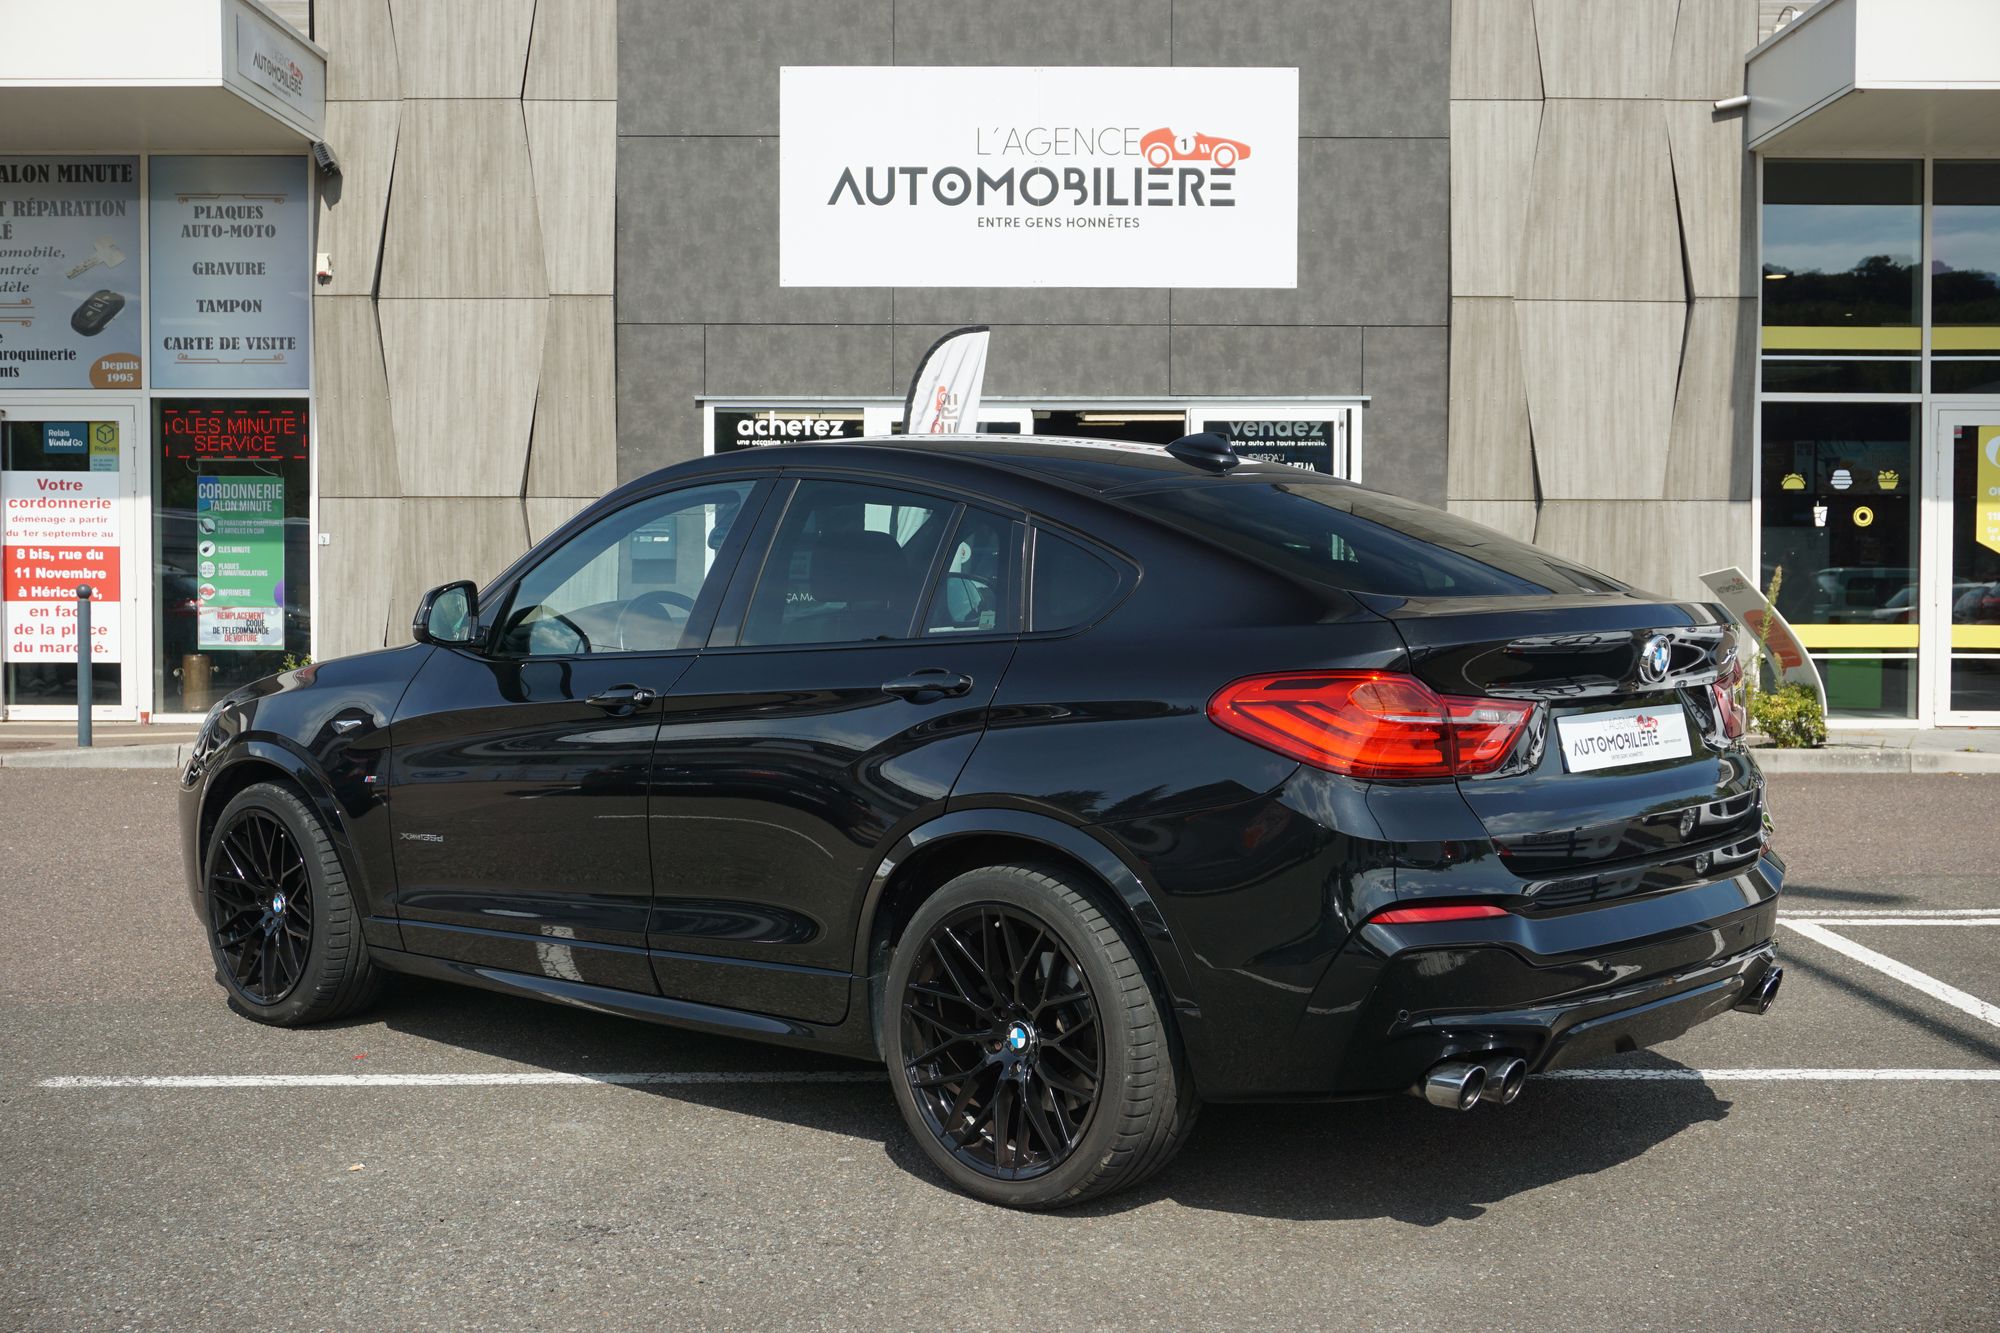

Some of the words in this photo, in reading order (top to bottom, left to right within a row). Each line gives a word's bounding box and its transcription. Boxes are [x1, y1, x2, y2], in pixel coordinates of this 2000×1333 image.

[977, 127, 1140, 156] L'AGENCE
[1181, 138, 1187, 151] 1
[57, 163, 133, 183] MINUTE
[827, 166, 1236, 207] AUTOMOBILIERE
[13, 197, 127, 217] RÉPARATION
[193, 205, 264, 220] PLAQUES
[977, 217, 1021, 228] ENTRE
[1025, 217, 1062, 228] GENS
[1066, 213, 1140, 228] HONNÊTES
[181, 224, 276, 238] AUTO-MOTO
[192, 261, 266, 276] GRAVURE
[196, 299, 262, 313] TAMPON
[163, 336, 213, 351] CARTE
[219, 336, 240, 351] DE
[245, 336, 296, 351] VISITE
[101, 360, 140, 371] Depuis
[107, 373, 134, 383] 1995
[172, 417, 221, 434] CLES
[227, 417, 296, 434] MINUTE
[737, 410, 844, 436] achetez
[48, 429, 70, 437] Relais
[48, 438, 72, 446] Vinted
[1248, 439, 1264, 447] auto
[37, 478, 83, 491] Votre
[198, 483, 283, 499] CORDONNERIE
[8, 496, 112, 509] cordonnerie
[209, 500, 237, 512] TALON
[239, 500, 272, 512] MINUTE
[79, 516, 108, 525] partir
[6, 529, 19, 537] du
[23, 529, 38, 537] 1er
[42, 529, 98, 539] septembre
[101, 530, 114, 538] au
[16, 548, 26, 560] 8
[29, 548, 55, 562] bis,
[58, 550, 82, 560] rue
[86, 548, 104, 560] du
[14, 566, 30, 579] 11
[35, 567, 107, 579] Novembre
[18, 585, 27, 598] à
[31, 586, 103, 600] Héricot,
[218, 588, 251, 597] IMPRIMERIE
[29, 607, 49, 617] en
[55, 605, 79, 617] fac
[216, 611, 265, 620] REMPLACEMENT
[246, 619, 265, 627] COQUE
[14, 623, 34, 636] de
[40, 623, 55, 636] la
[61, 623, 108, 638] plce
[212, 627, 220, 635] DE
[224, 634, 232, 642] DE
[233, 634, 257, 642] VOITURE
[13, 641, 34, 653] du
[1574, 729, 1660, 757] AUTOMOBILIERE
